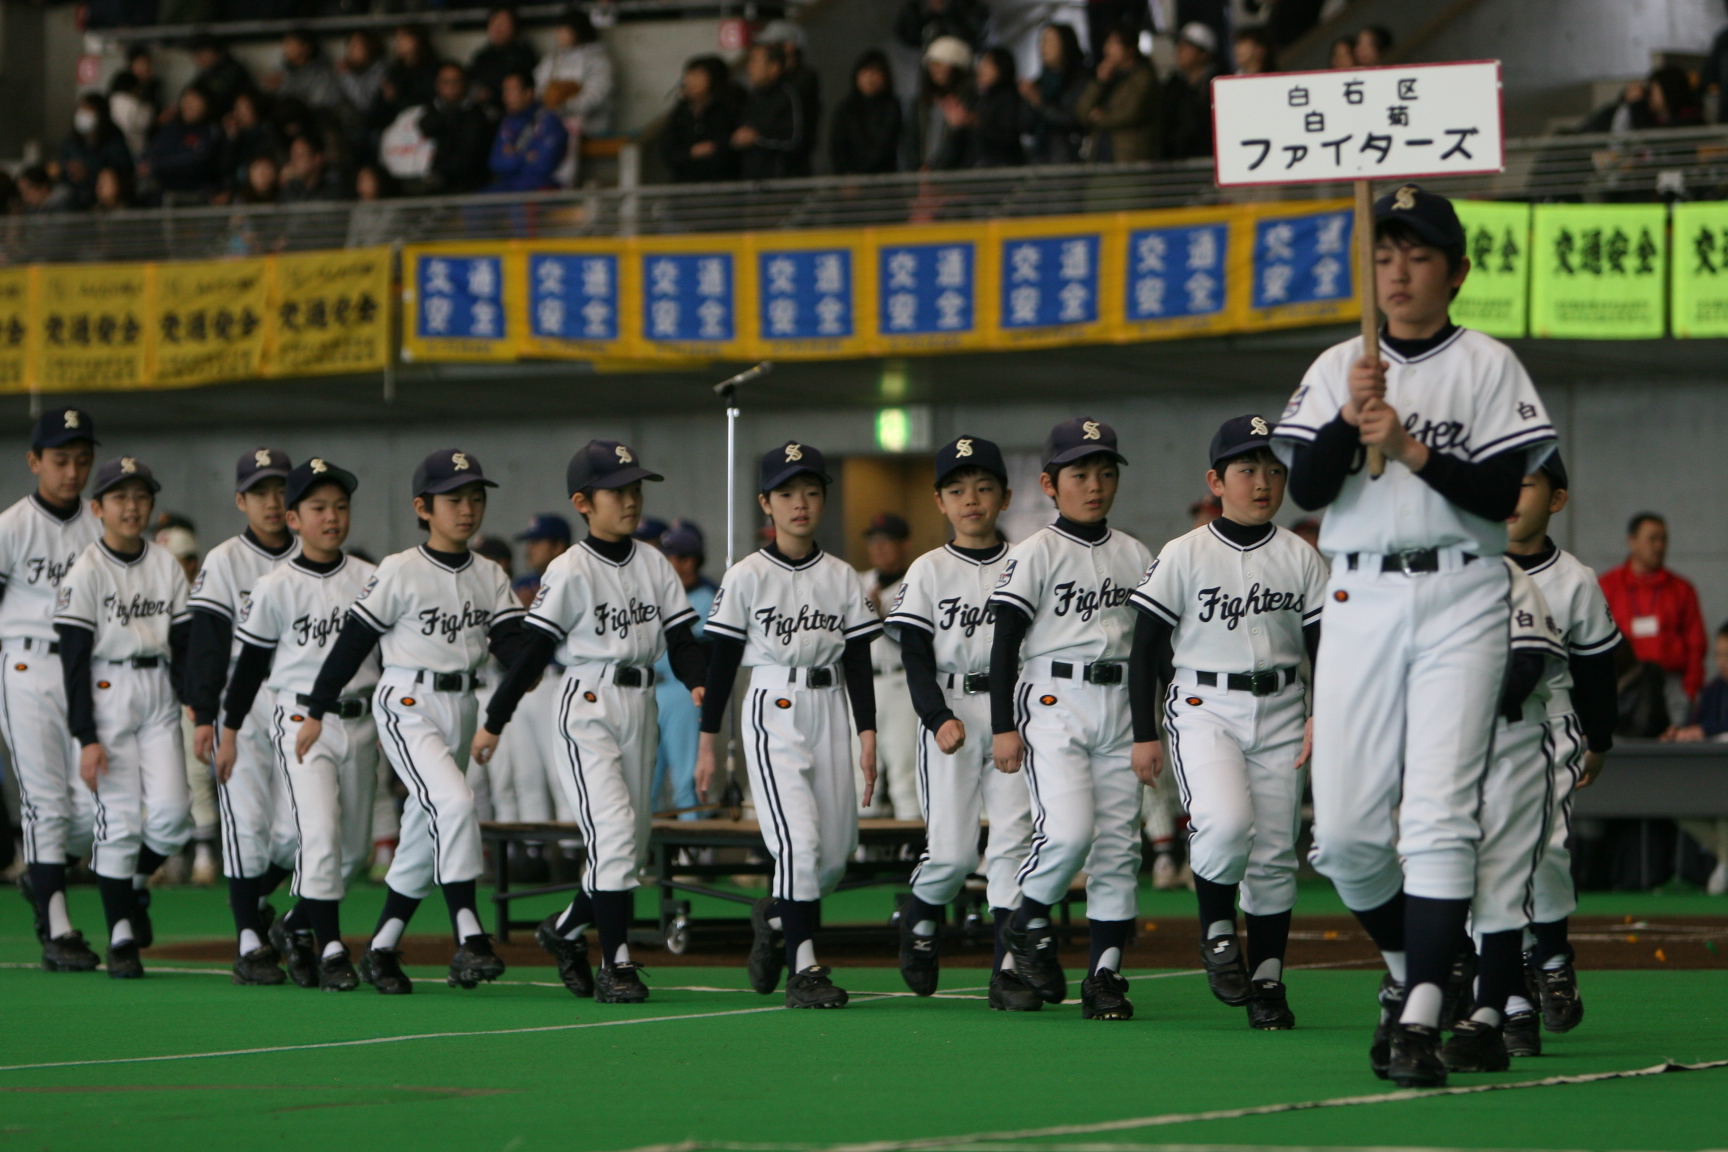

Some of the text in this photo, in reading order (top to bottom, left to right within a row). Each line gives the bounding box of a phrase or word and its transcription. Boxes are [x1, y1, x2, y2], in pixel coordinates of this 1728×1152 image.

[1288, 78, 1418, 107] 白石区
[1304, 106, 1408, 132] 白菊
[1240, 127, 1479, 170] ファイターズ
[64, 410, 80, 429] S
[1517, 402, 1537, 421] 白
[1083, 421, 1101, 440] S
[1250, 416, 1269, 436] S
[615, 445, 632, 464] S
[785, 444, 803, 462] S
[955, 438, 974, 458] S
[121, 457, 137, 473] S
[255, 449, 272, 467] S
[310, 458, 327, 475] S
[452, 453, 470, 471] S
[1198, 583, 1305, 631] Fighters
[755, 604, 846, 646] Fighters
